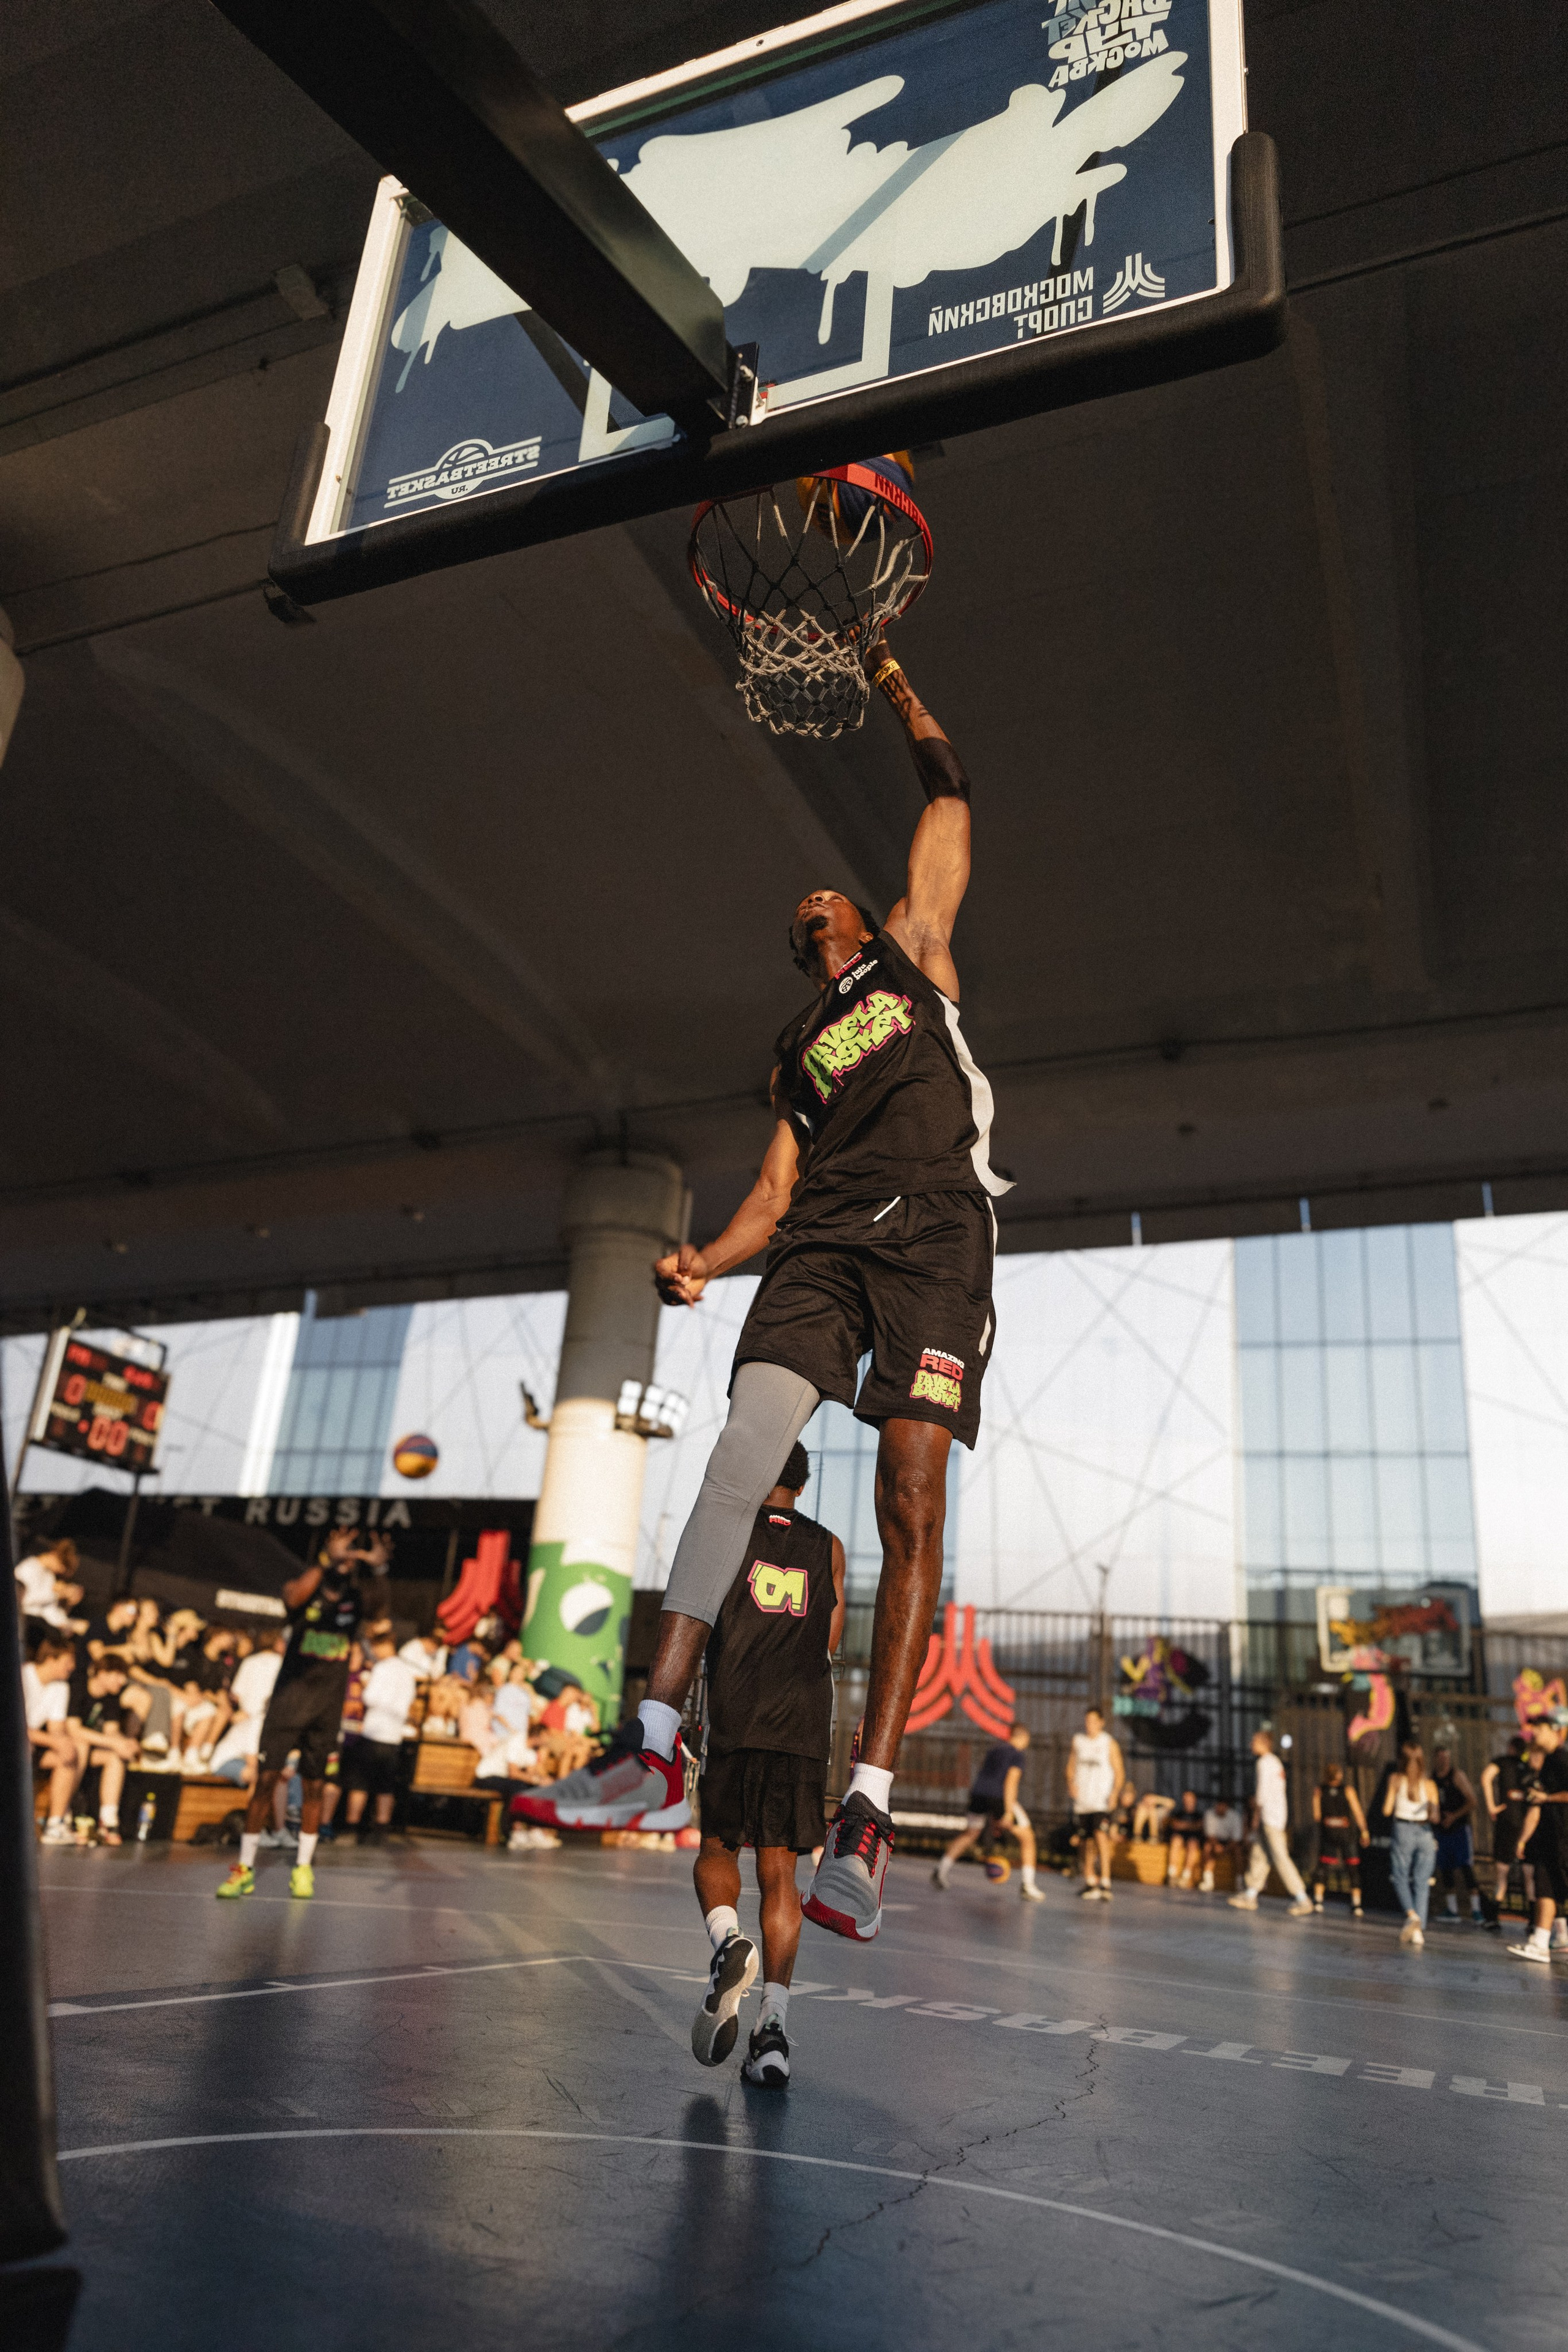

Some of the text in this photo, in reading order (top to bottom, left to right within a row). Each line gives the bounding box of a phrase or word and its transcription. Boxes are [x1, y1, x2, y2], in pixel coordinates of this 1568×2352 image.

[856, 959, 878, 980] people
[919, 1354, 963, 1381] RED
[922, 1348, 965, 1369] AMAZING
[244, 1496, 412, 1529] RUSSIA
[769, 1517, 791, 1526] RED
